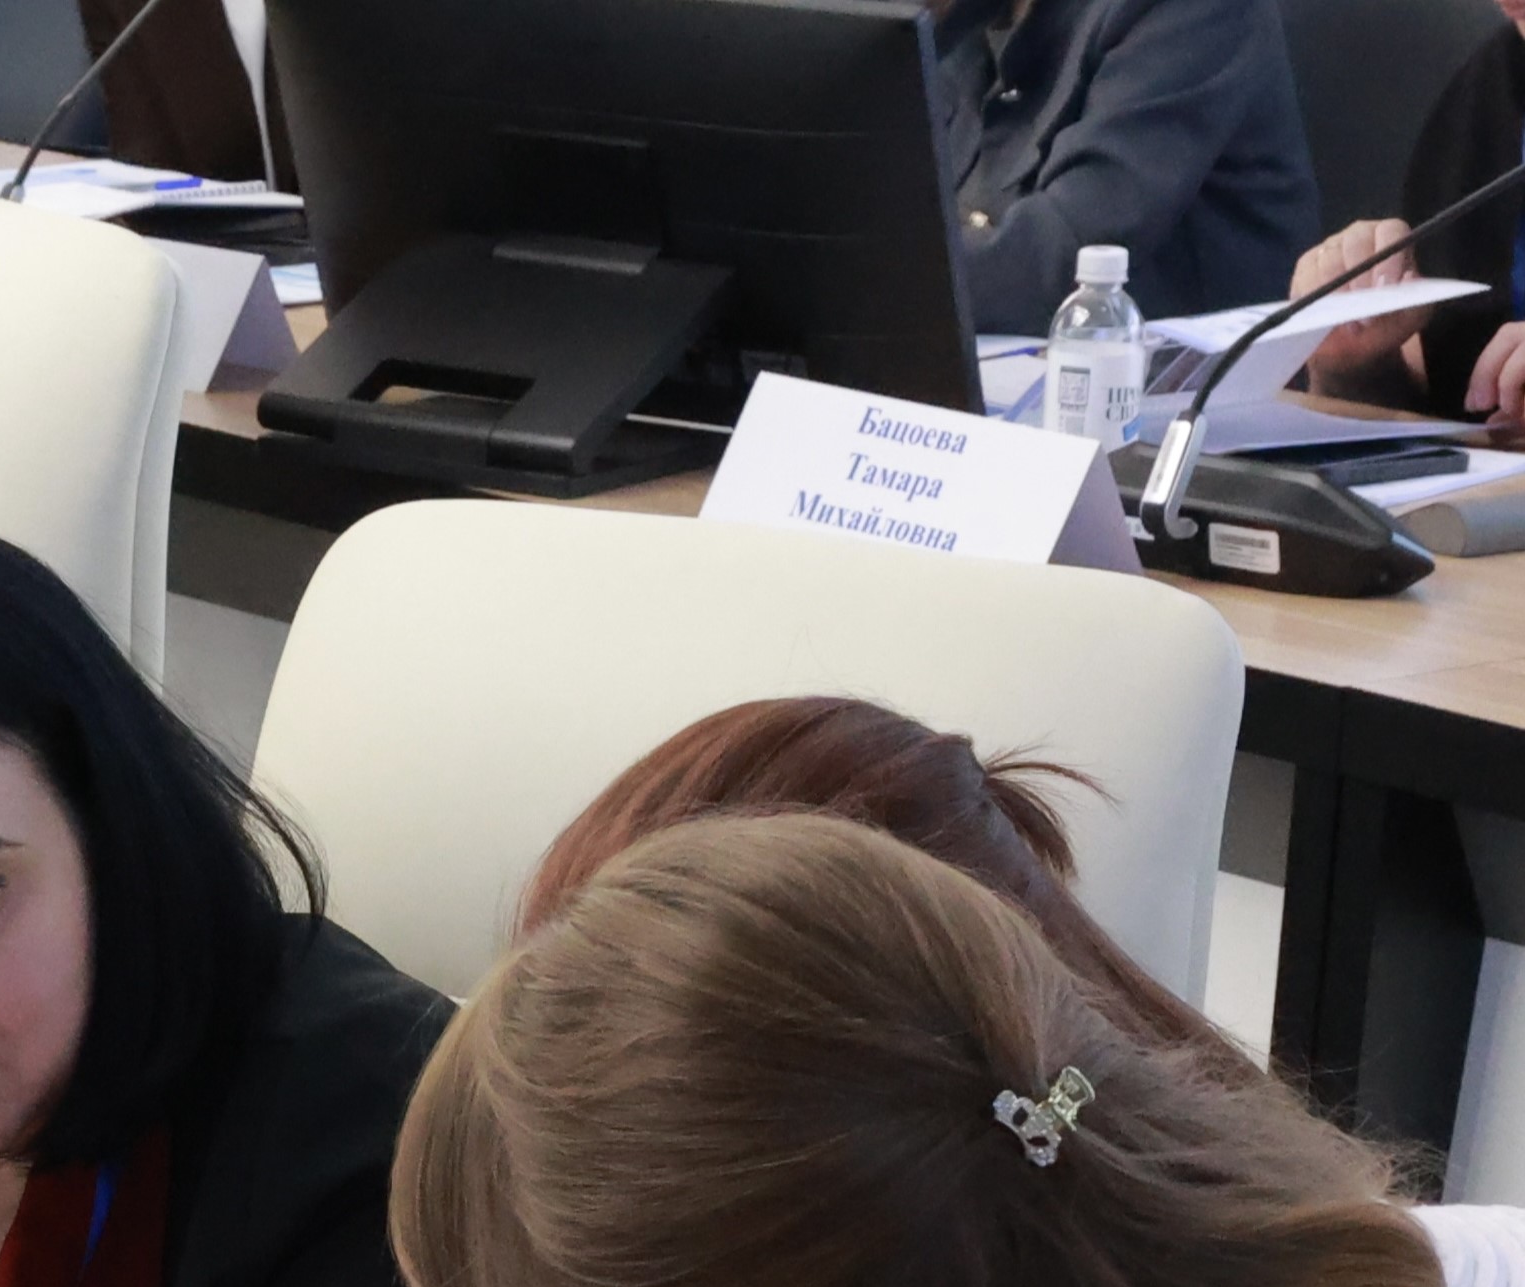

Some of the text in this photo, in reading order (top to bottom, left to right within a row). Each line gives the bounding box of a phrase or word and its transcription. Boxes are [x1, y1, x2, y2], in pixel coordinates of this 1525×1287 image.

[857, 406, 968, 455] Бацоева
[846, 452, 944, 502] Тамара
[789, 489, 958, 552] Михайловна
